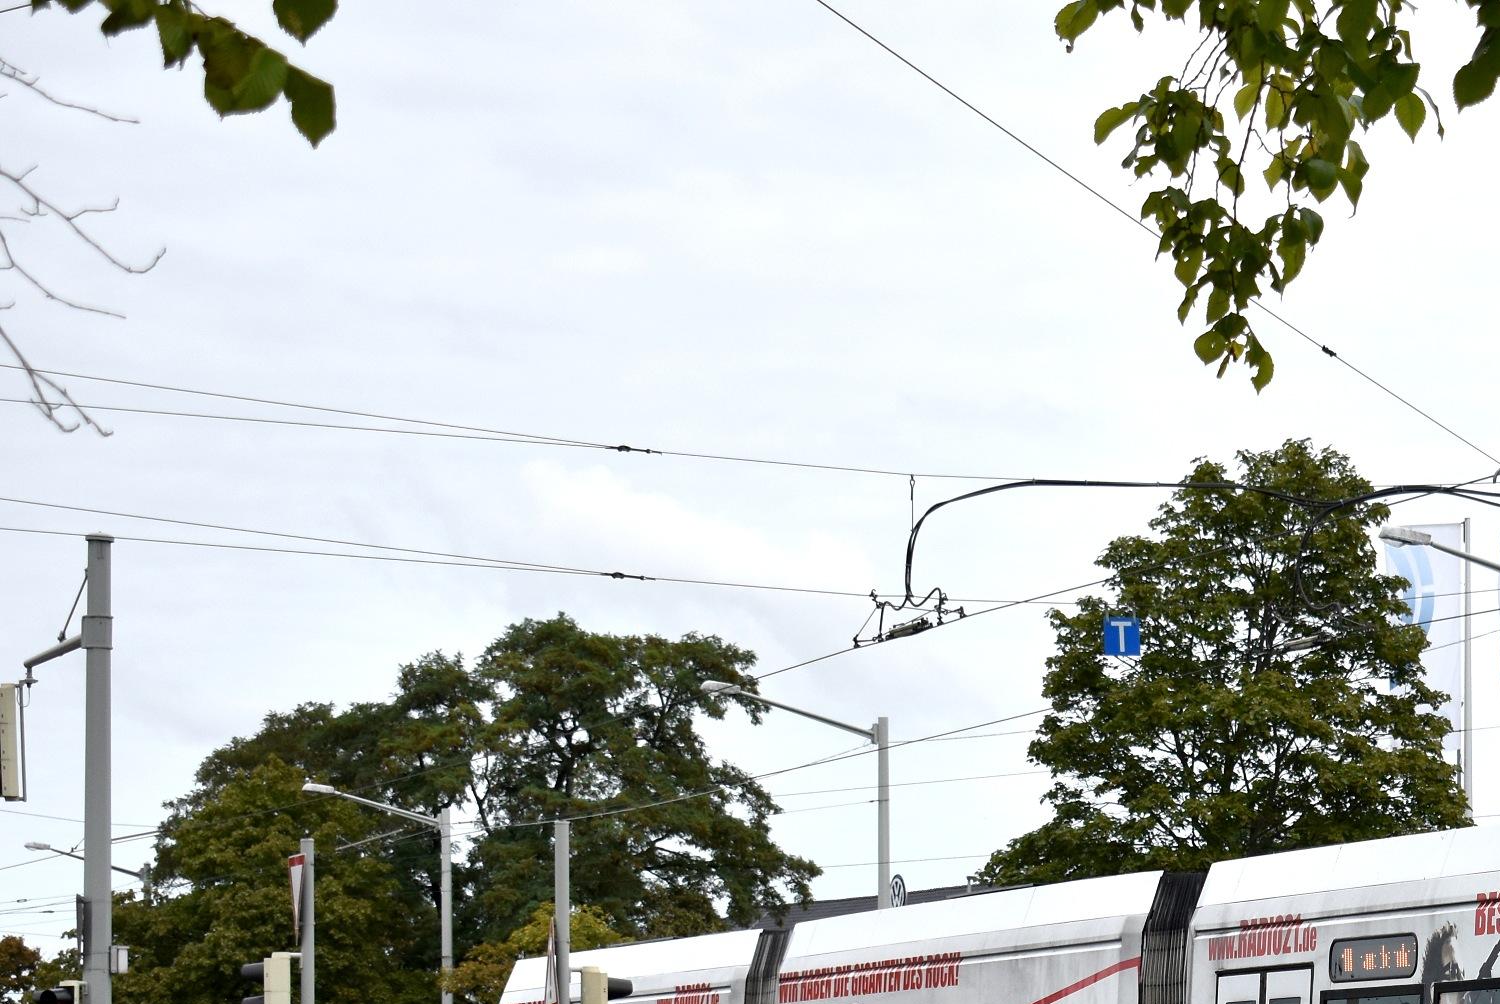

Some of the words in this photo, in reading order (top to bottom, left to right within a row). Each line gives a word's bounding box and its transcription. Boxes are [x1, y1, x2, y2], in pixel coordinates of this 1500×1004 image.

[1110, 621, 1132, 653] T
[1208, 913, 1317, 961] www.RADIO21.de
[779, 971, 799, 1003] WIR
[800, 966, 834, 1001] HABEN
[834, 962, 852, 998] DIE
[851, 957, 903, 996] GIGANTEN
[903, 955, 924, 991] DES
[925, 952, 961, 988] ROCK!
